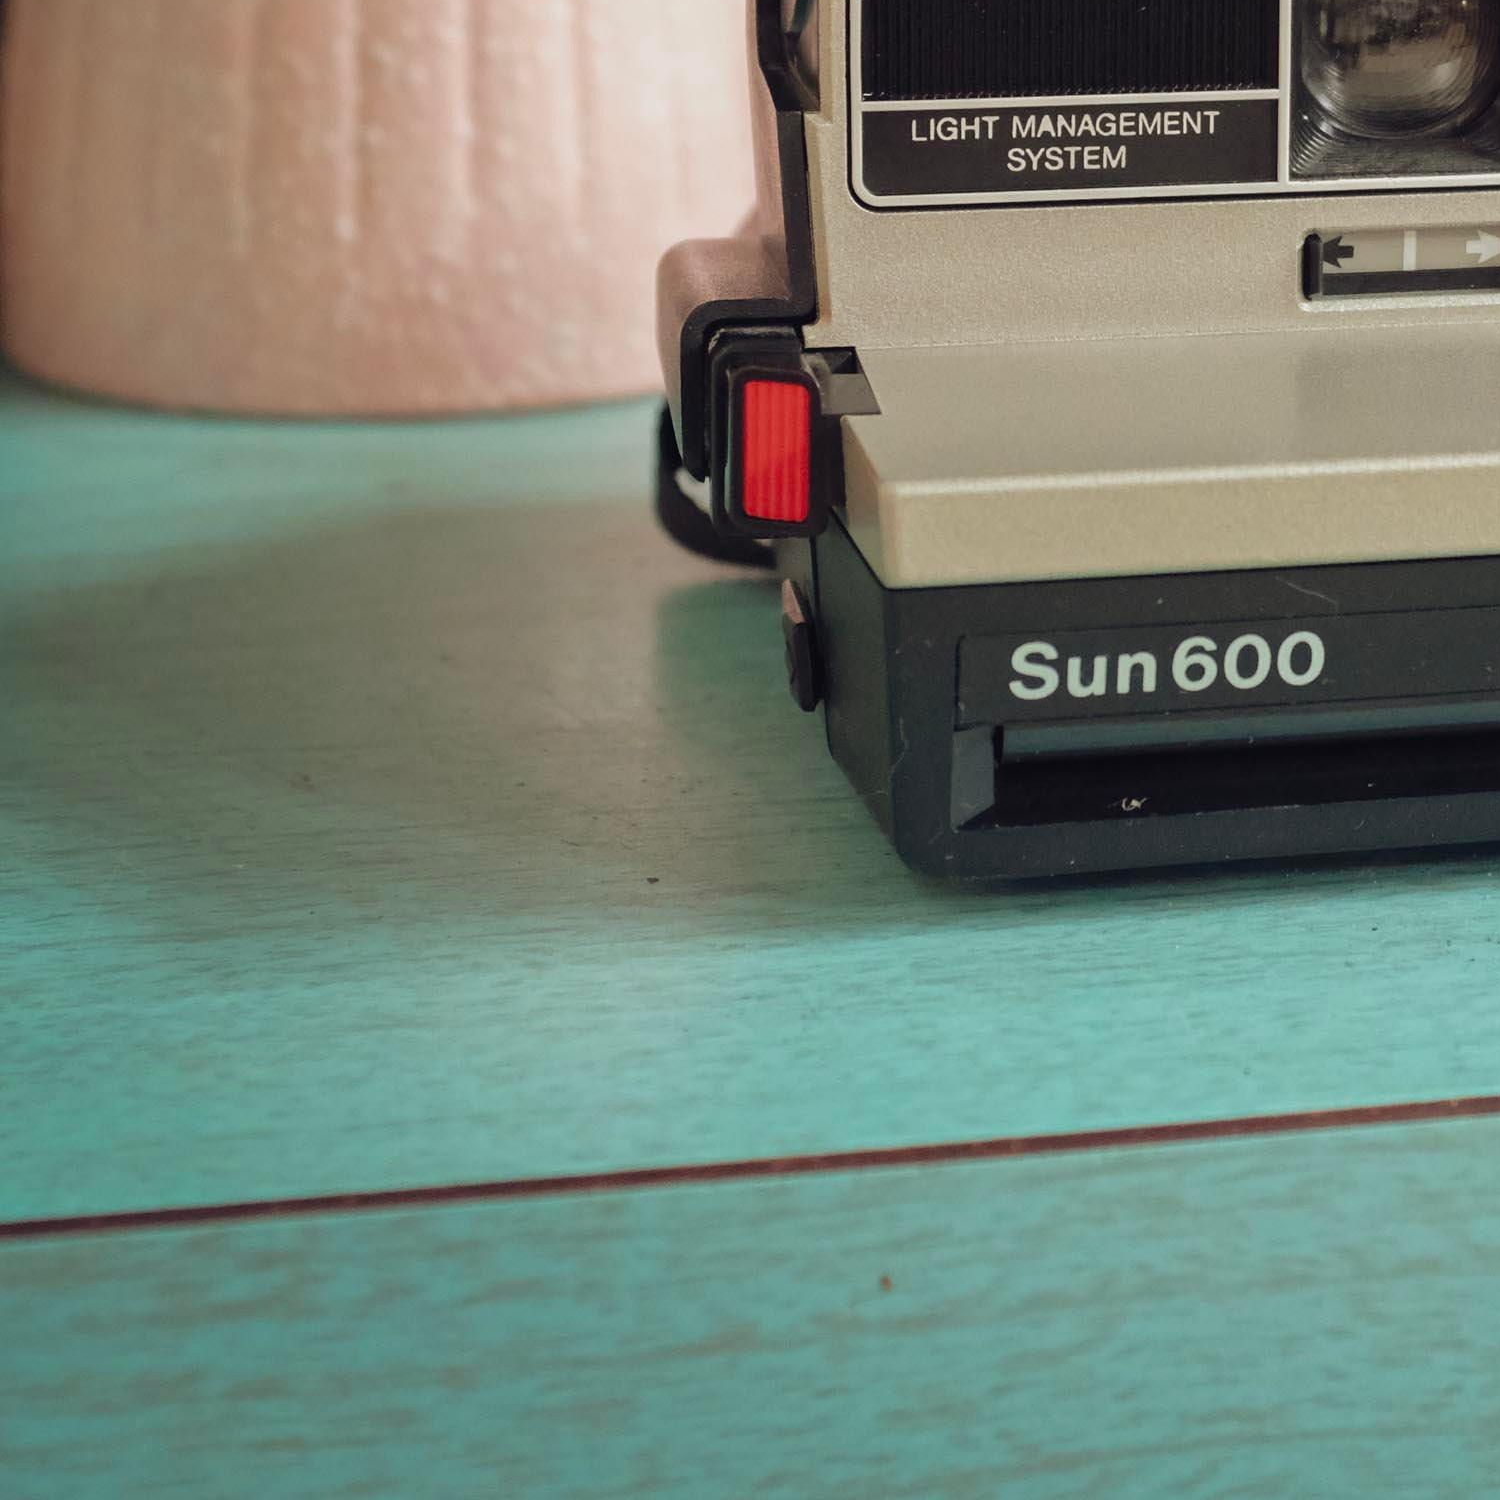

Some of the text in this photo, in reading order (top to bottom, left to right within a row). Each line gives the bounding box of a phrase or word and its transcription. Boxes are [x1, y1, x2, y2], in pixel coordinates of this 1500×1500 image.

[911, 110, 1221, 142] LIGHT MANAGEMENT
[1006, 144, 1127, 172] SYSTEM
